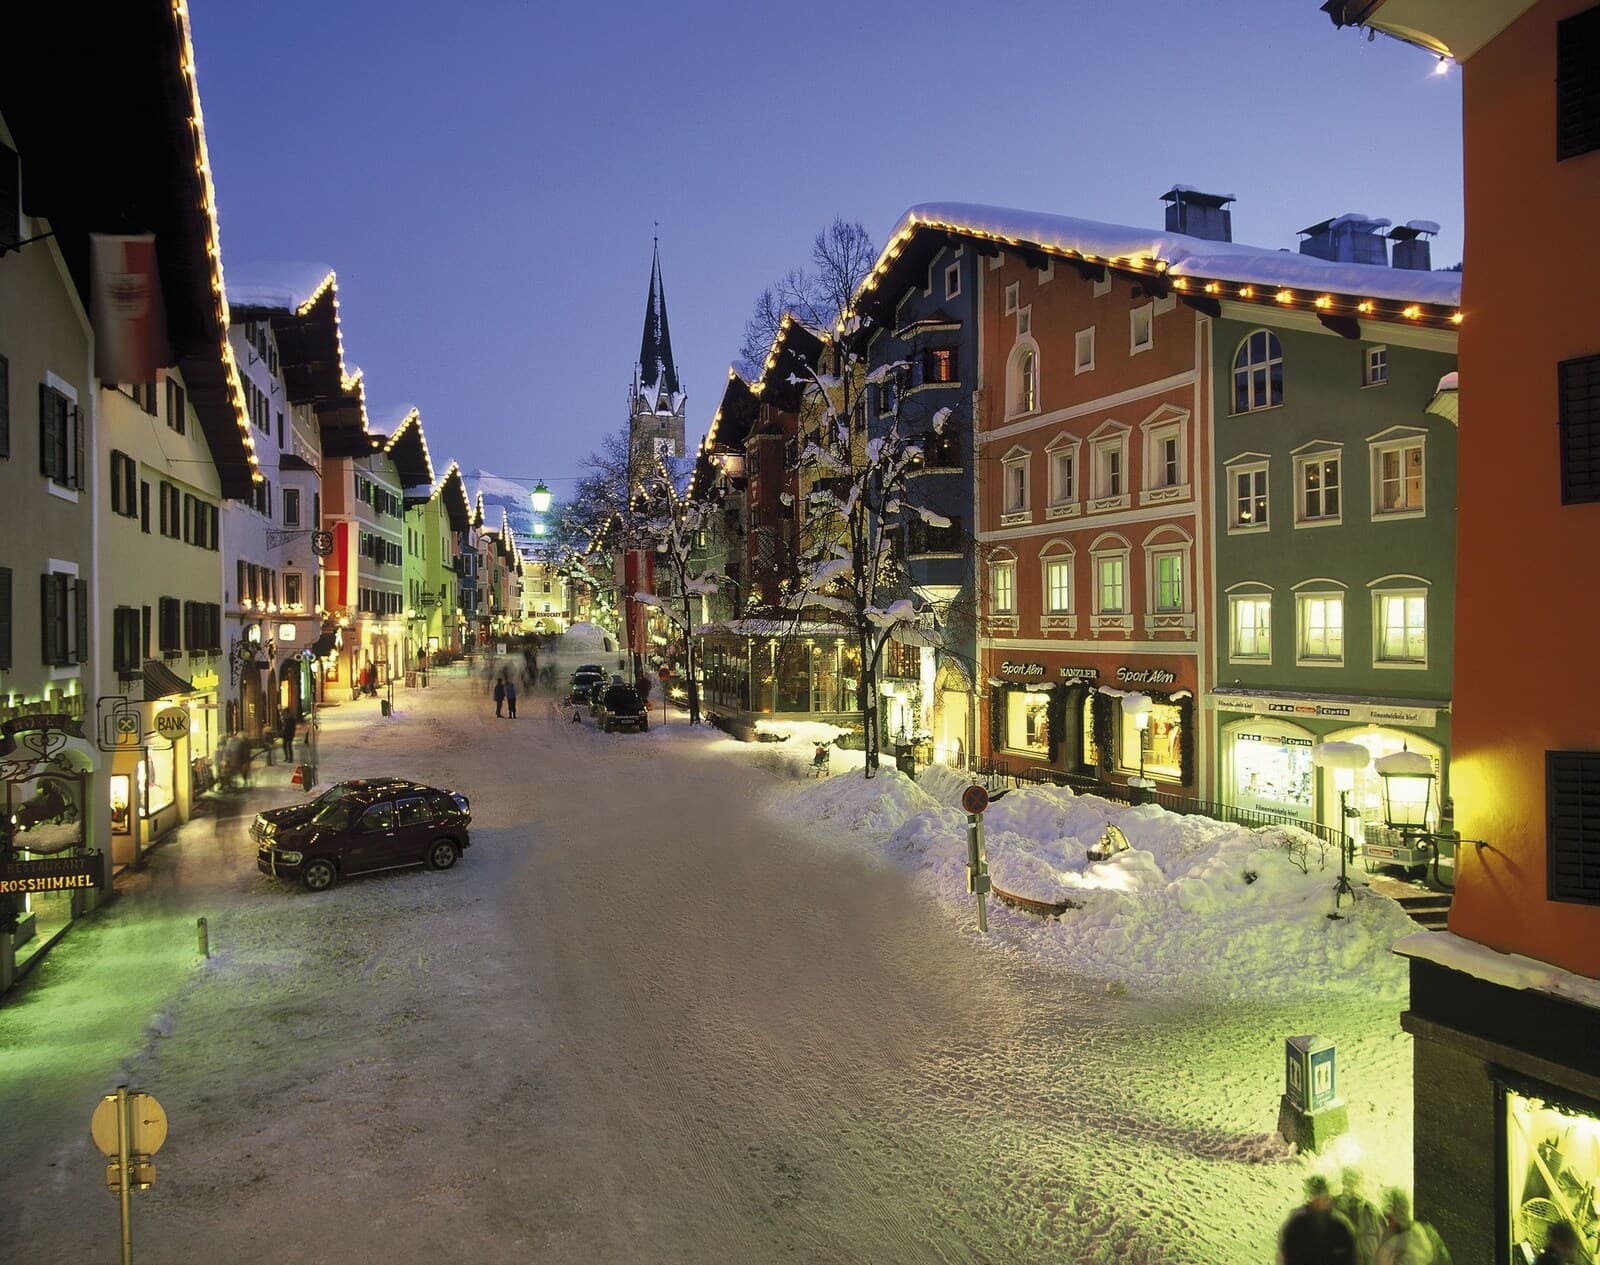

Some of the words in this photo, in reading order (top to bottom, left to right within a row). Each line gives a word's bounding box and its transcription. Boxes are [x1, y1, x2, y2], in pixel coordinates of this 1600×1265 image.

[1001, 661, 1026, 675] Sport
[1060, 668, 1097, 679] KANZLER
[1117, 667, 1149, 682] Sport
[1148, 669, 1174, 683] Alm
[157, 716, 186, 731] BANK
[8, 859, 86, 873] RESTAURANT
[0, 874, 94, 893] ROSSHIMMEL
